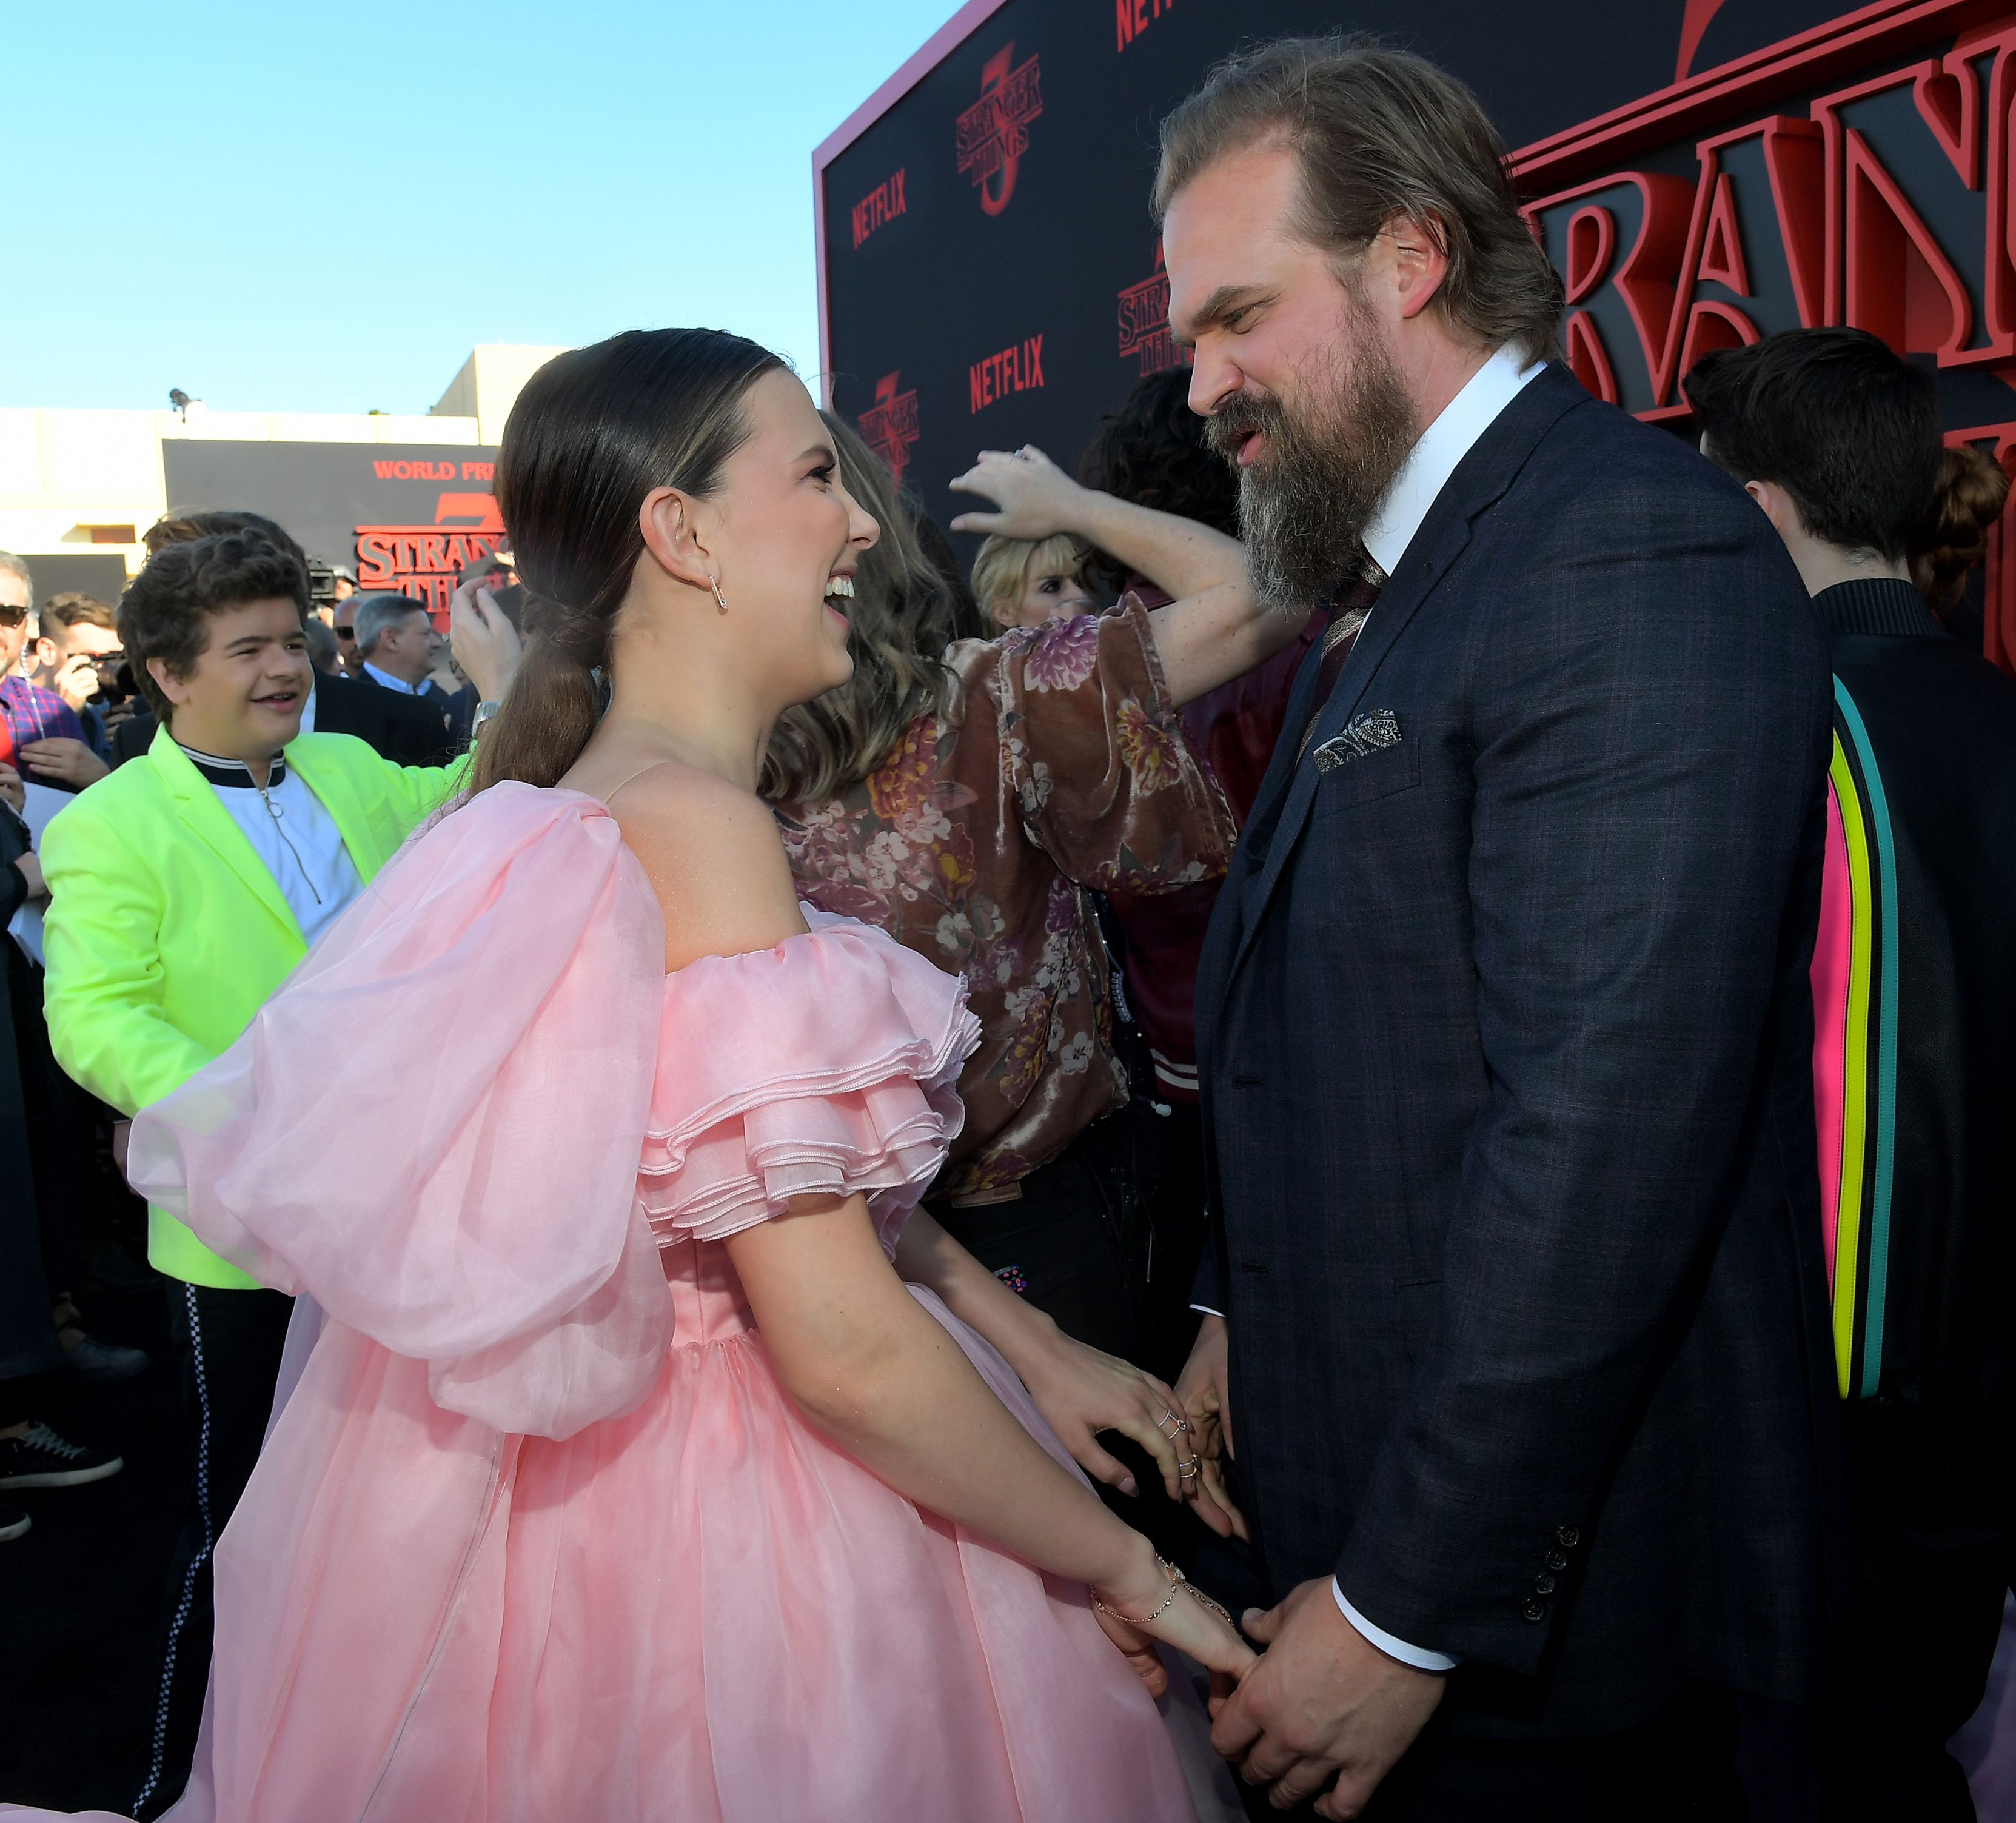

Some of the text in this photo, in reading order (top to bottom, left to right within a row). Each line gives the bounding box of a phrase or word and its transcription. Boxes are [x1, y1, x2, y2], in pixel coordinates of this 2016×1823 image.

[852, 167, 906, 250] NETFLIX
[1517, 27, 2016, 423] RAN
[971, 334, 1045, 415] NETFLIX
[373, 461, 456, 480] WORLD
[357, 532, 508, 581] STRAN
